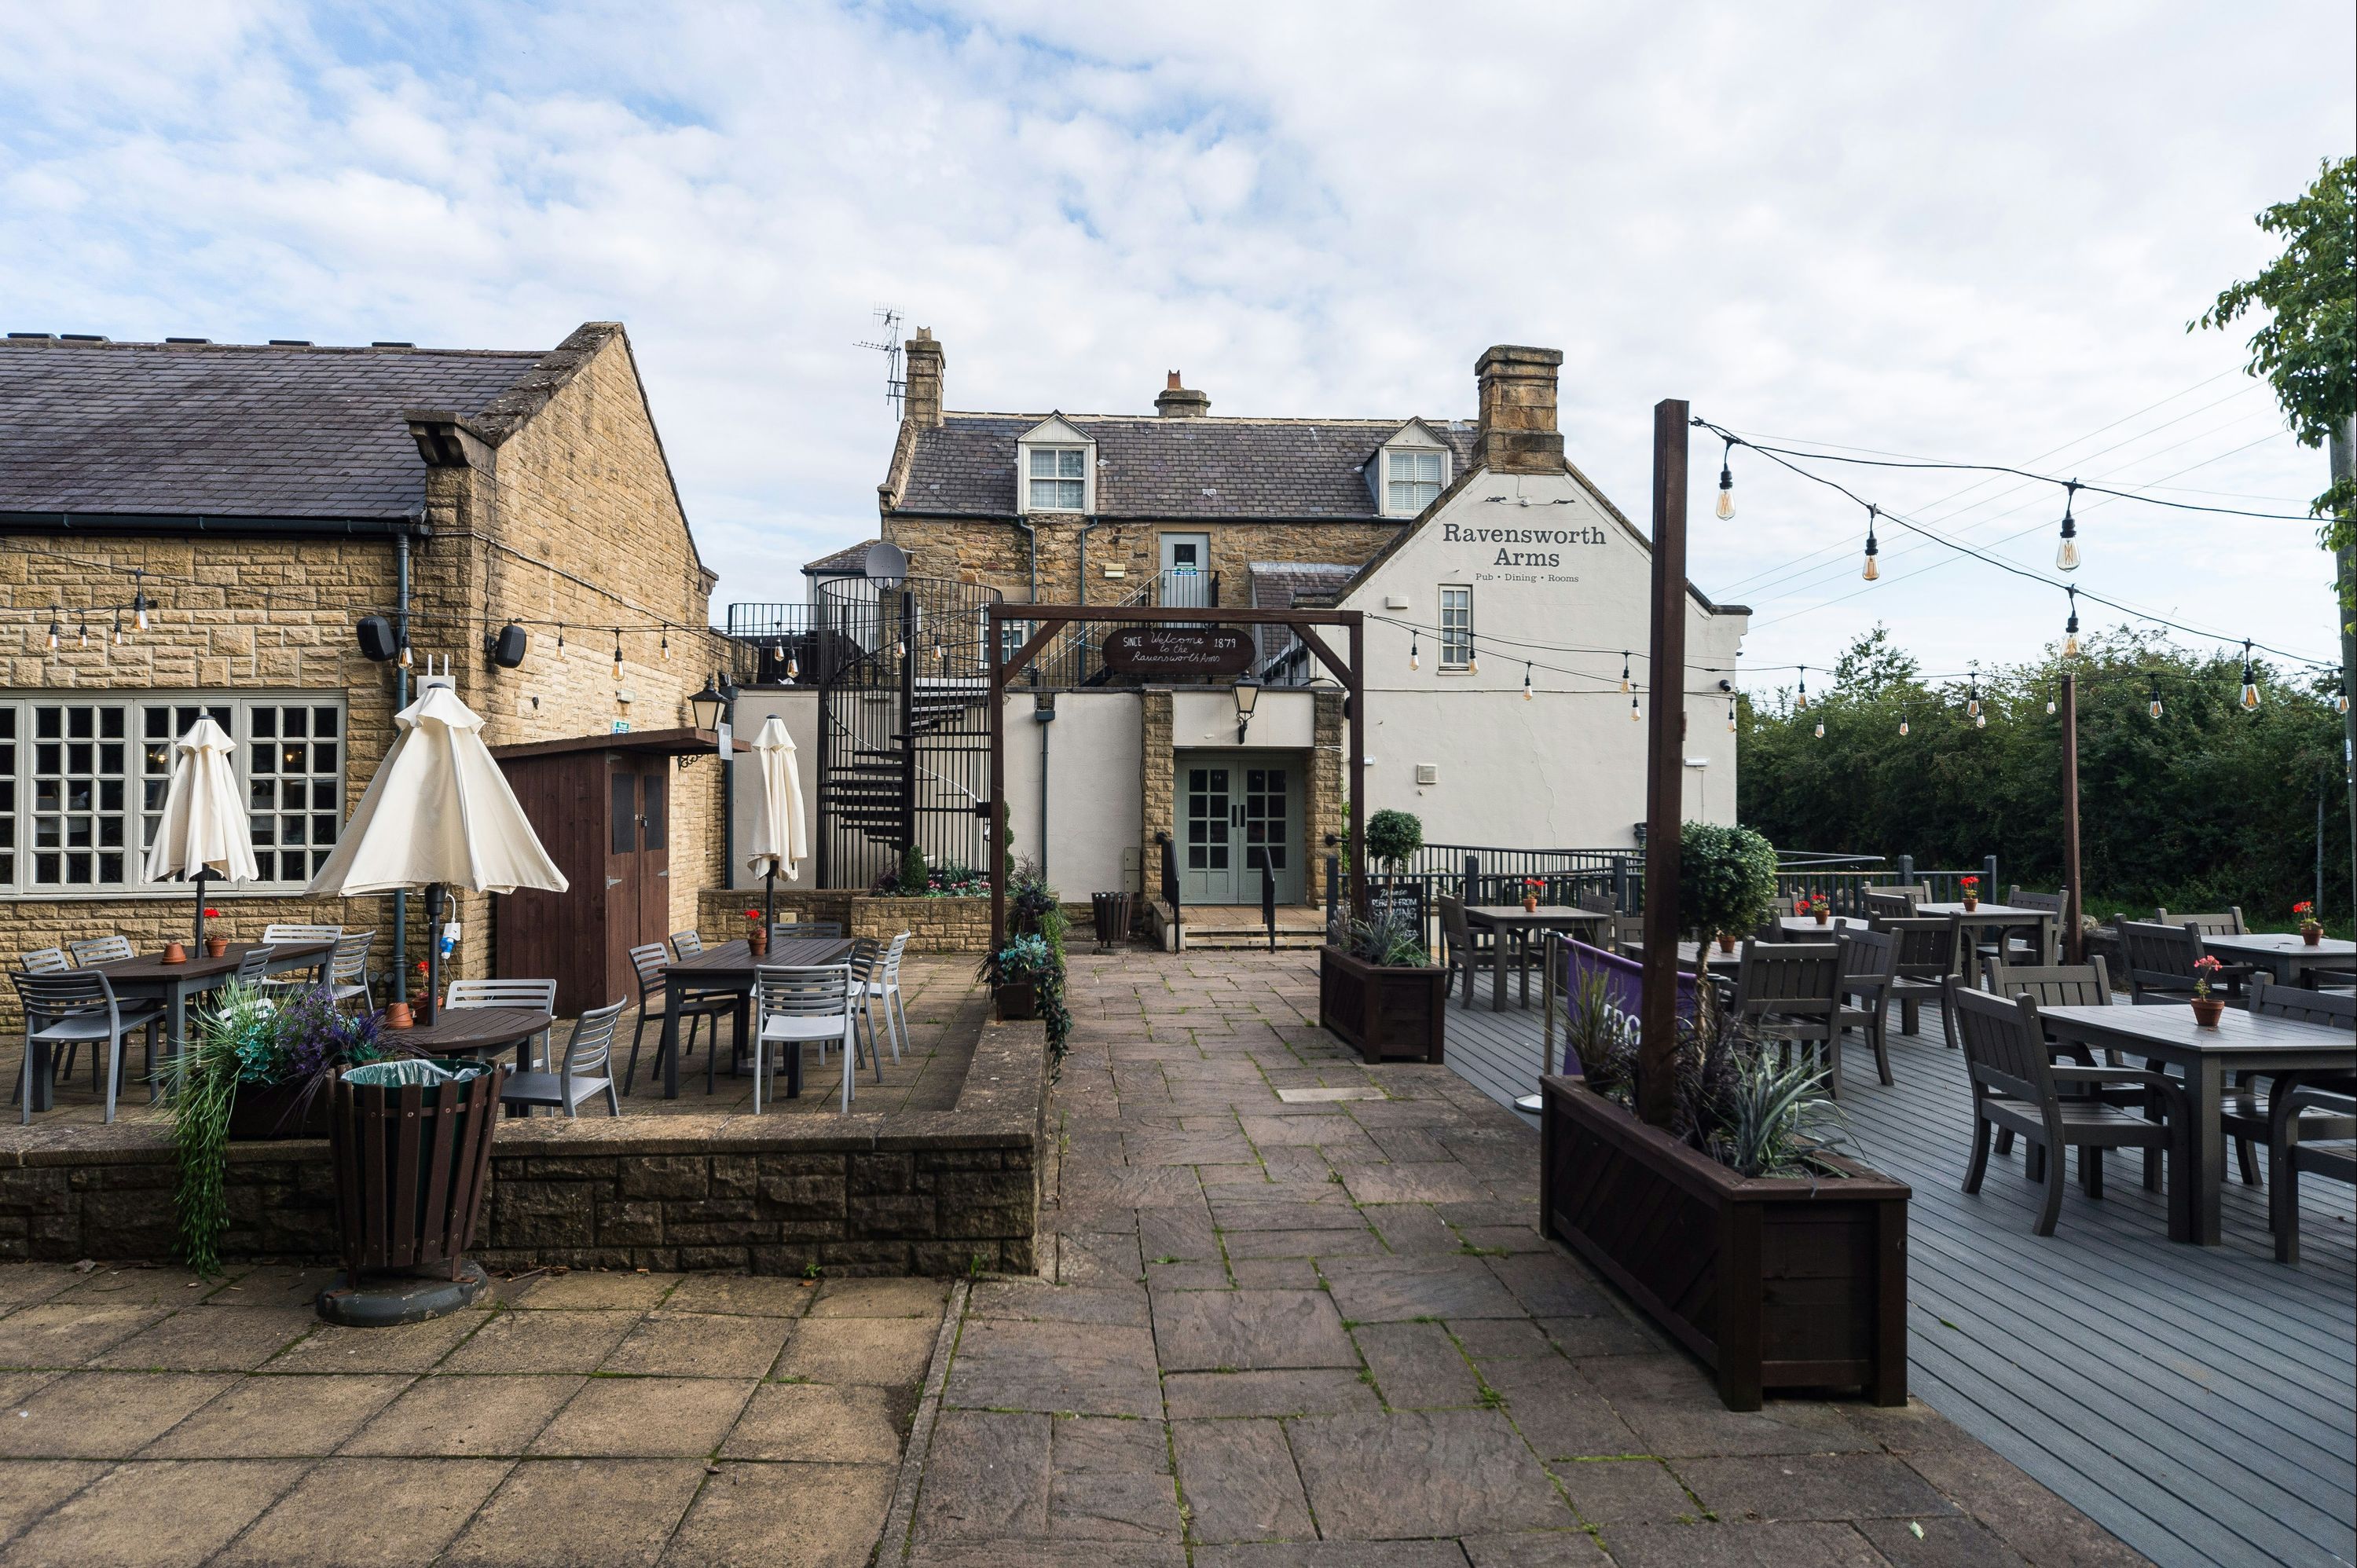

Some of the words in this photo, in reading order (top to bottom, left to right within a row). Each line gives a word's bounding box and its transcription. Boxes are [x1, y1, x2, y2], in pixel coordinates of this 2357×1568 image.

[1443, 523, 1607, 544] Ravensworth
[1494, 548, 1560, 567] Arms
[1505, 573, 1537, 583] Dining
[1548, 574, 1579, 583] Rooms
[1124, 636, 1142, 647] SINCE
[1150, 632, 1204, 644] Welcome
[1214, 638, 1236, 648] 1879
[1174, 644, 1188, 654] the
[1131, 651, 1199, 662] Ravensworth
[1200, 653, 1220, 662] Arms
